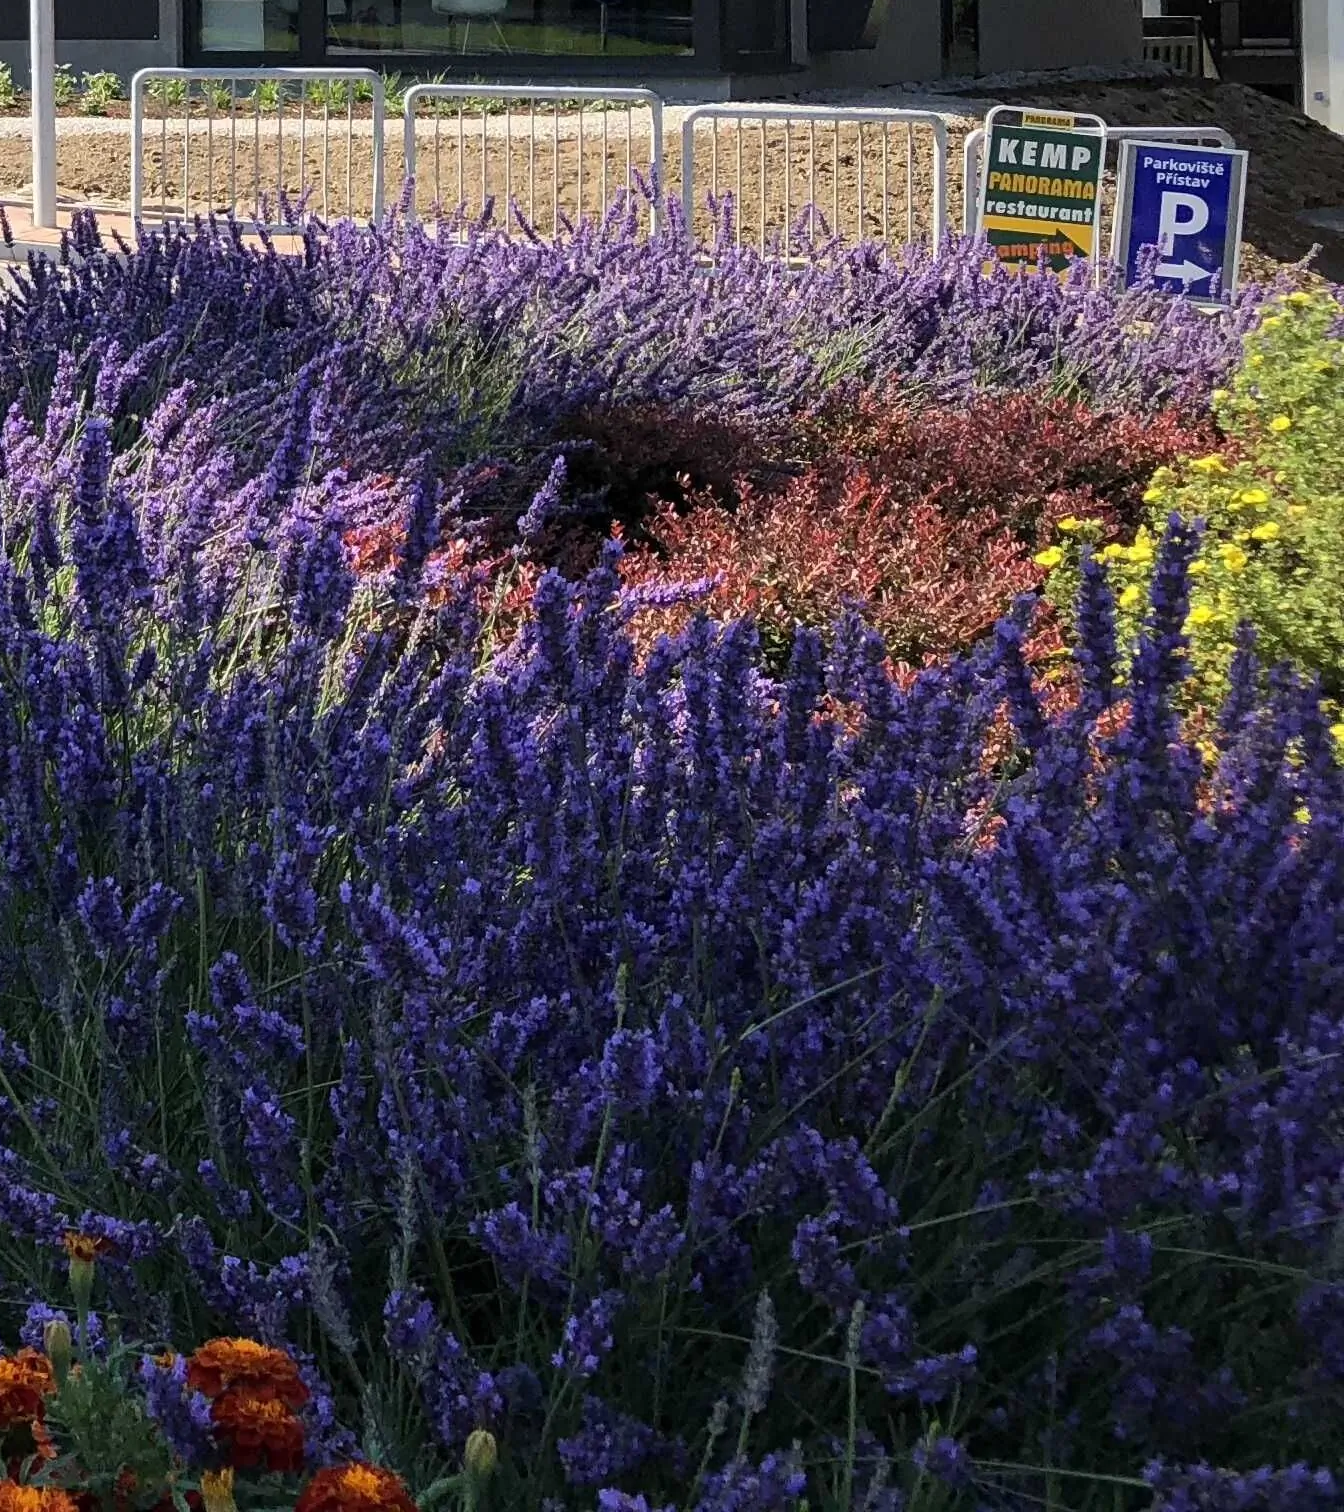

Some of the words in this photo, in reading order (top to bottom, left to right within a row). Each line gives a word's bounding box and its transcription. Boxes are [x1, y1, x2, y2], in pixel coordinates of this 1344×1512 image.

[998, 138, 1091, 171] KEMP
[1143, 156, 1225, 176] Parkoviště
[988, 171, 1095, 200] PANORAMA
[1156, 171, 1210, 189] Přístav
[986, 200, 1093, 223] restaurant
[1158, 191, 1210, 256] P
